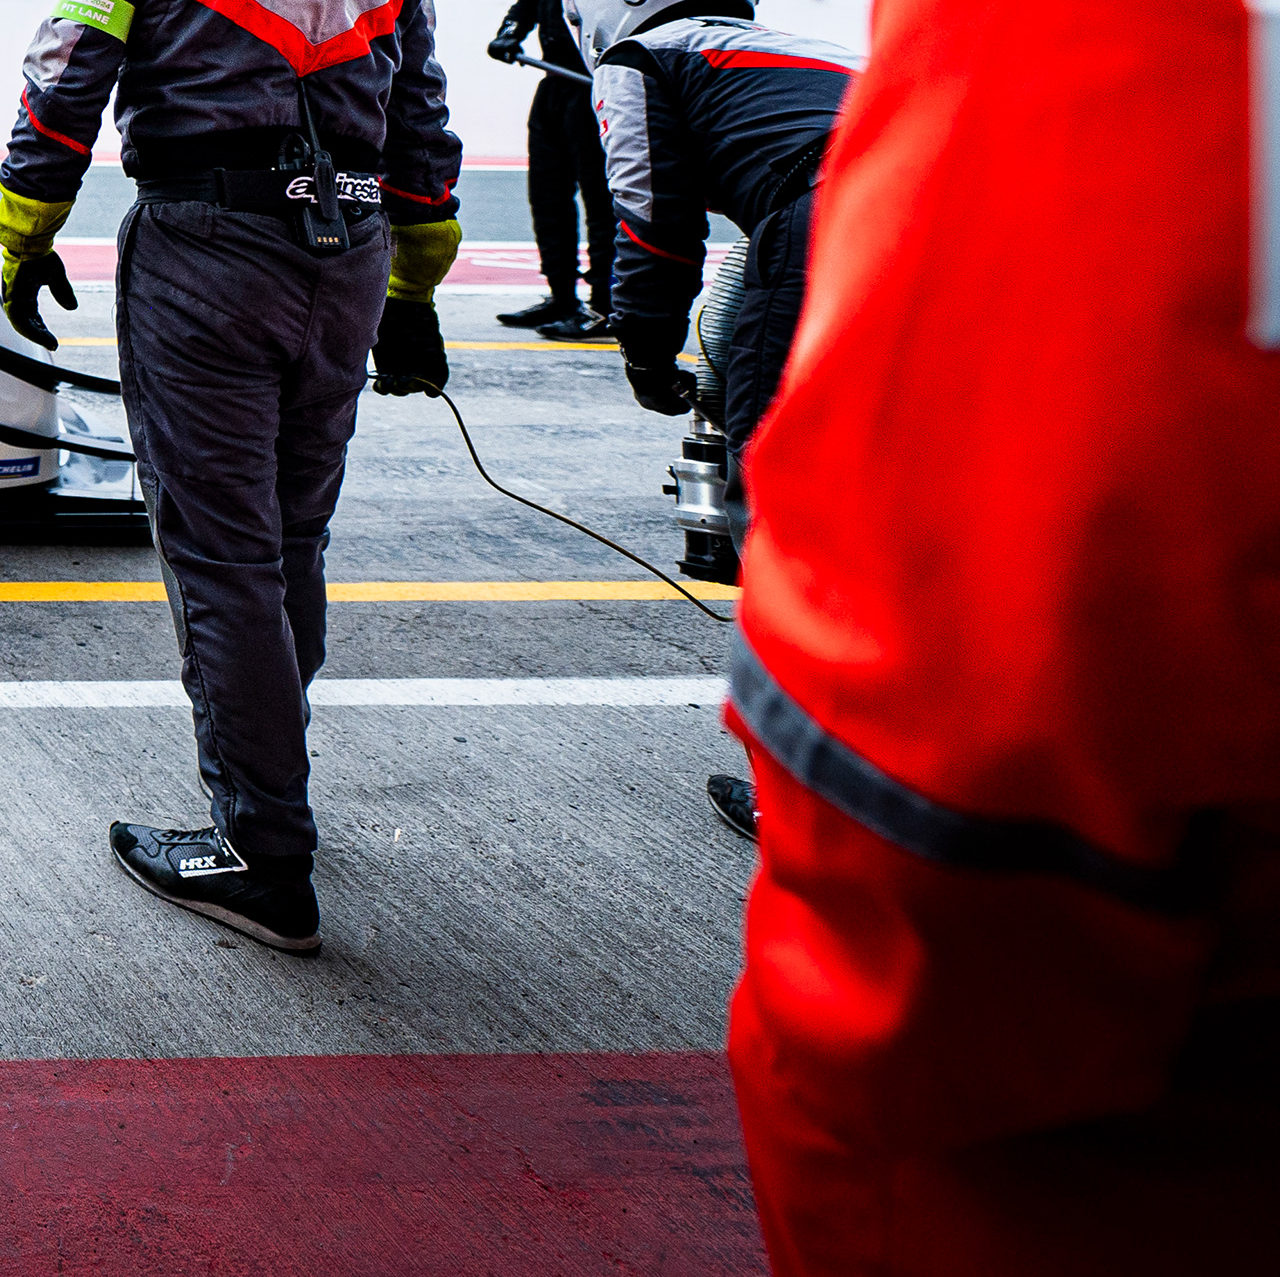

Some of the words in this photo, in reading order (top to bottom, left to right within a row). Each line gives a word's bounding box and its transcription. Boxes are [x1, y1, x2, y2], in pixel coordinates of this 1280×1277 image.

[61, 2, 77, 13] PIT
[79, 4, 111, 25] LANE
[179, 855, 217, 870] HRX
